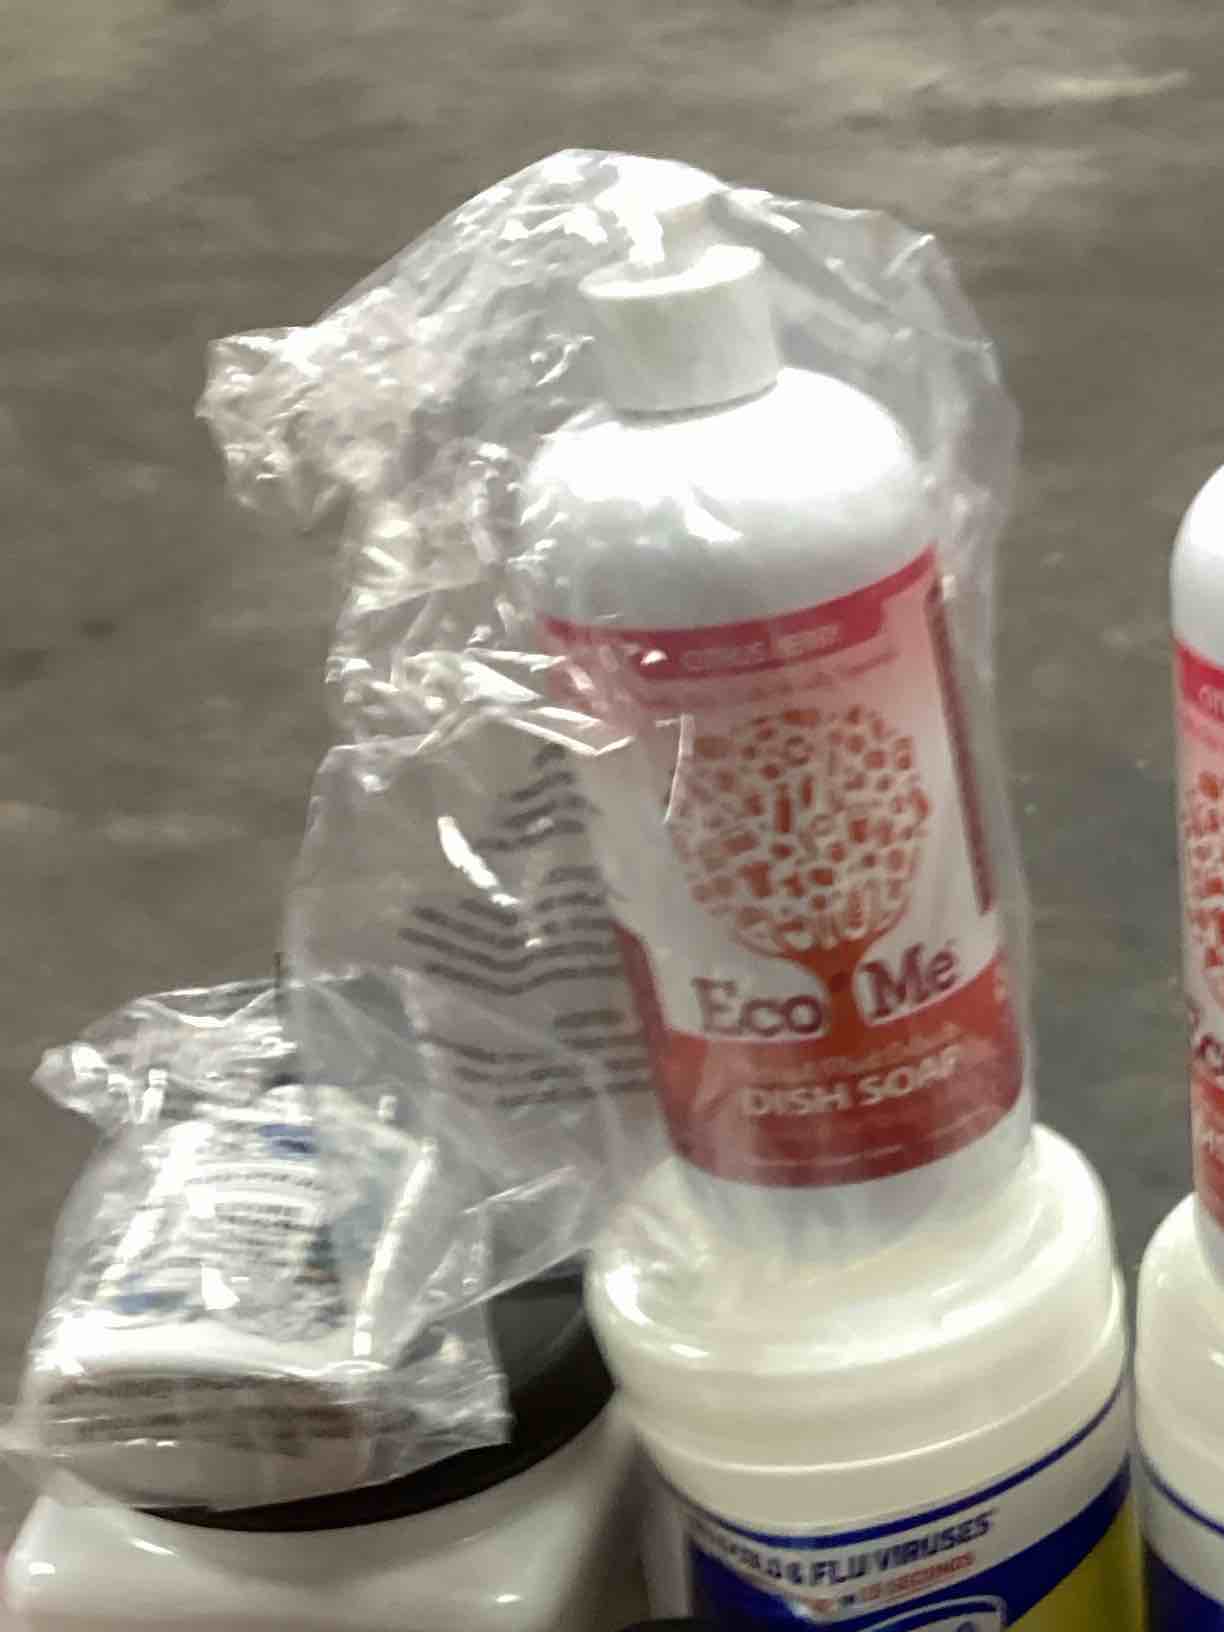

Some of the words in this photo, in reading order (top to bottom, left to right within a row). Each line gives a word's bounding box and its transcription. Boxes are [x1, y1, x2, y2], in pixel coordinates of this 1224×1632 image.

[691, 974, 823, 1037] Eco
[861, 944, 957, 1018] Me
[739, 1082, 850, 1118] DISH
[857, 1046, 961, 1106] SOAP
[809, 1556, 869, 1586] FLU
[872, 1510, 992, 1571] VIRUSES
